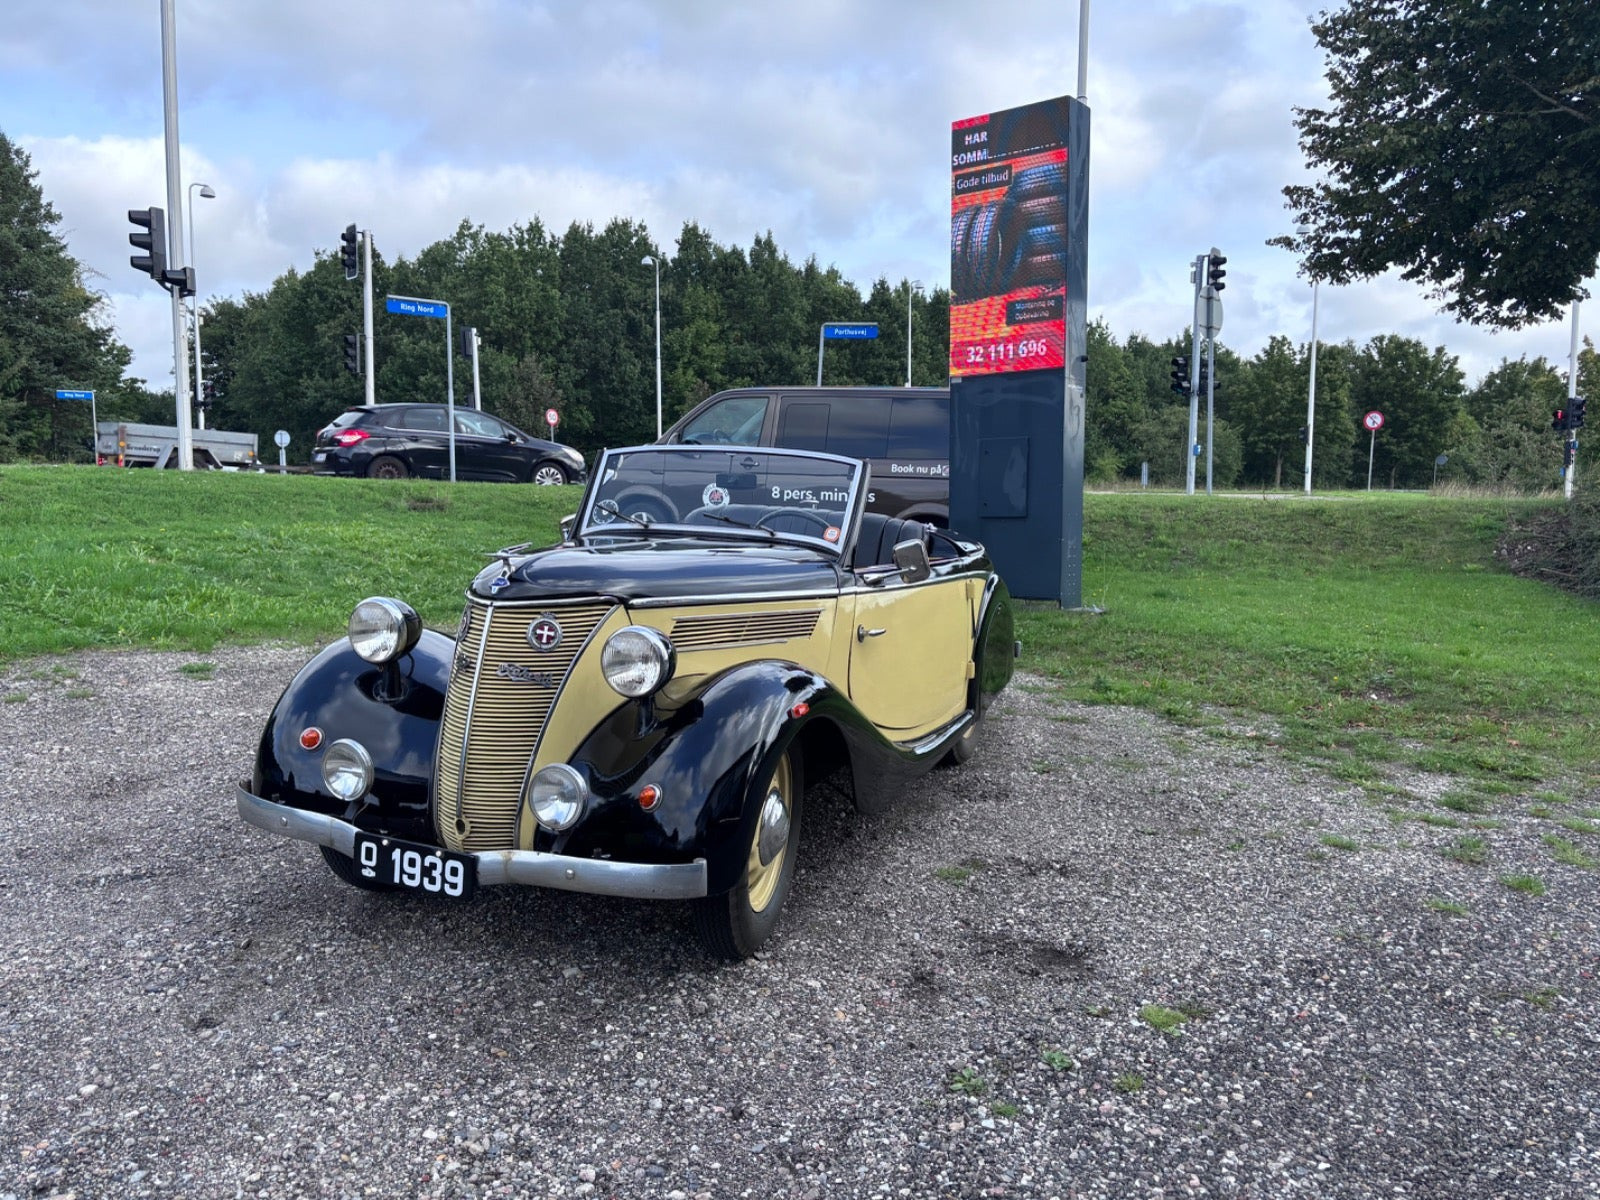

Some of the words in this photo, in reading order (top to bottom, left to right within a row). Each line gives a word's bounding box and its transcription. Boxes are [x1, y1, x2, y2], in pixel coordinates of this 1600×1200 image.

[965, 131, 988, 145] HAR
[956, 177, 980, 190] Gode
[981, 169, 1009, 185] tilbud
[400, 302, 415, 312] Ring
[417, 304, 435, 314] Nord
[966, 345, 984, 363] 32
[988, 342, 1014, 361] 111
[1018, 338, 1047, 358] 696
[891, 464, 914, 473] Book
[916, 465, 928, 474] nu
[930, 463, 942, 476] på
[771, 485, 781, 499] 8
[783, 488, 816, 501] pers.
[391, 847, 464, 897] 1939
